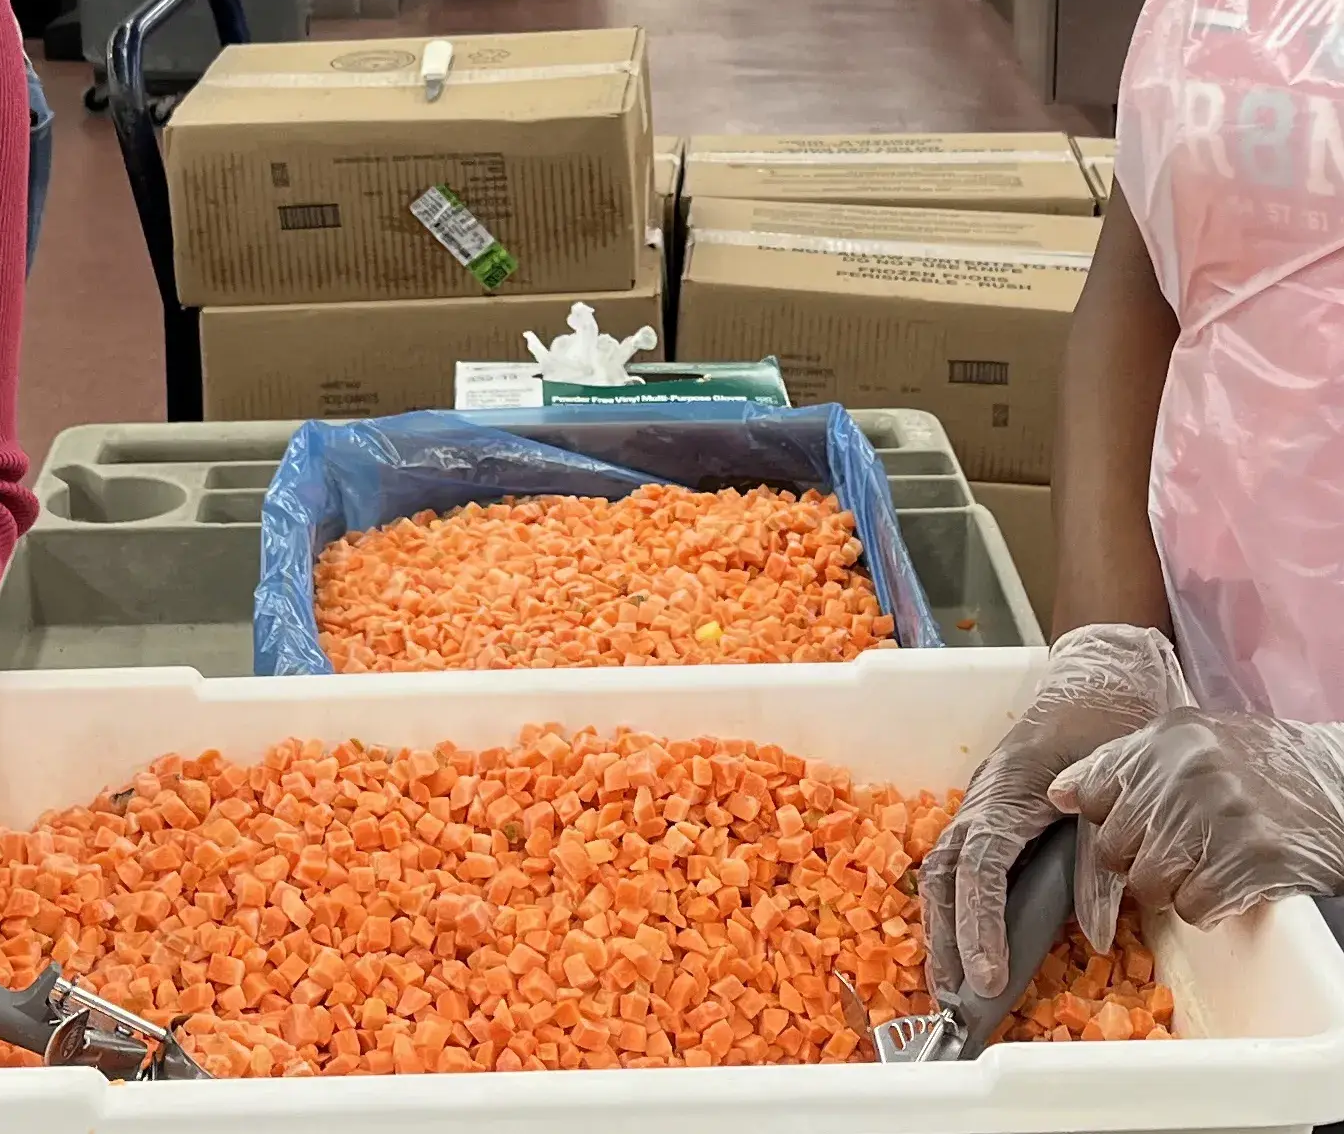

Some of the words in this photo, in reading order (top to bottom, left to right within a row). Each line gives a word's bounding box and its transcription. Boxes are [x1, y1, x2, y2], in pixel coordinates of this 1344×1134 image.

[836, 270, 958, 286] PERISHABLE
[978, 281, 1031, 291] RUSH
[858, 266, 936, 278] FROZEN
[942, 272, 1009, 284] FOODS
